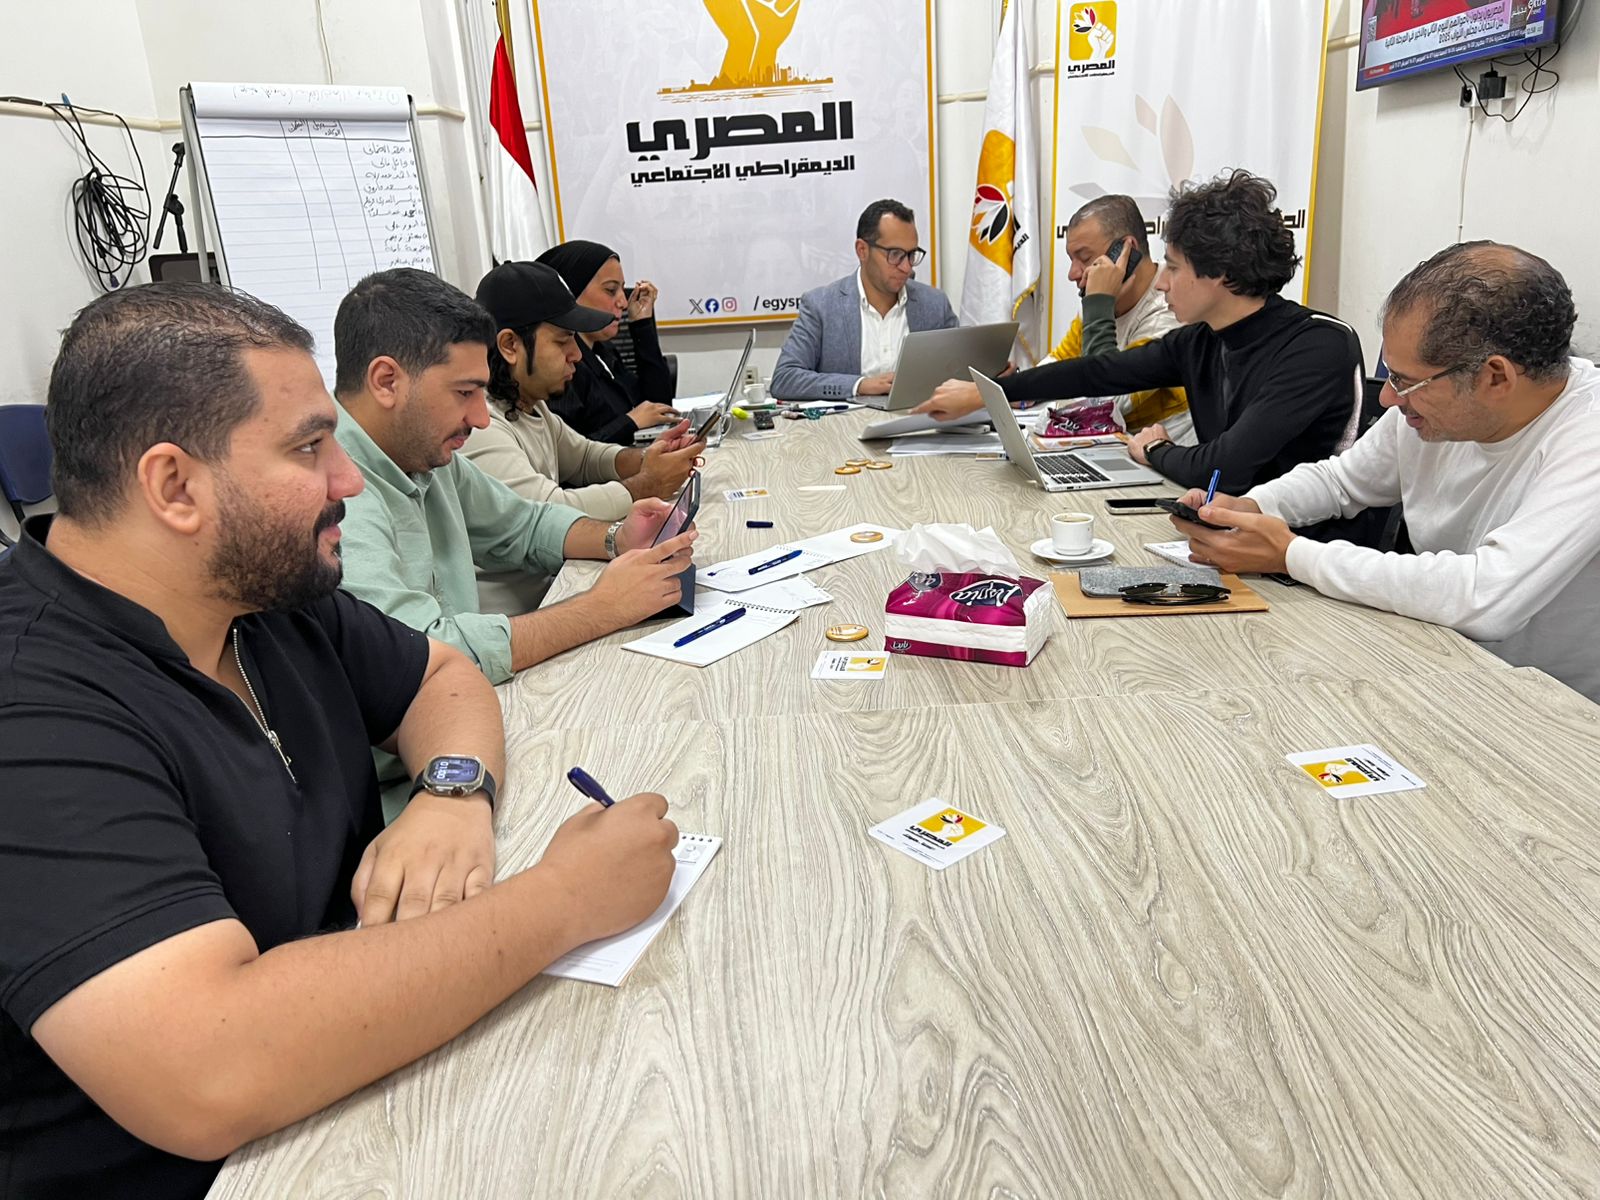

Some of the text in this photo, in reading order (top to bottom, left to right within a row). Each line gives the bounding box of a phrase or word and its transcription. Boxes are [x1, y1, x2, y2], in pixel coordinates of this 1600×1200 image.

[626, 101, 854, 161] المصري
[630, 155, 855, 187] الديمقراطي الاجتماعي
